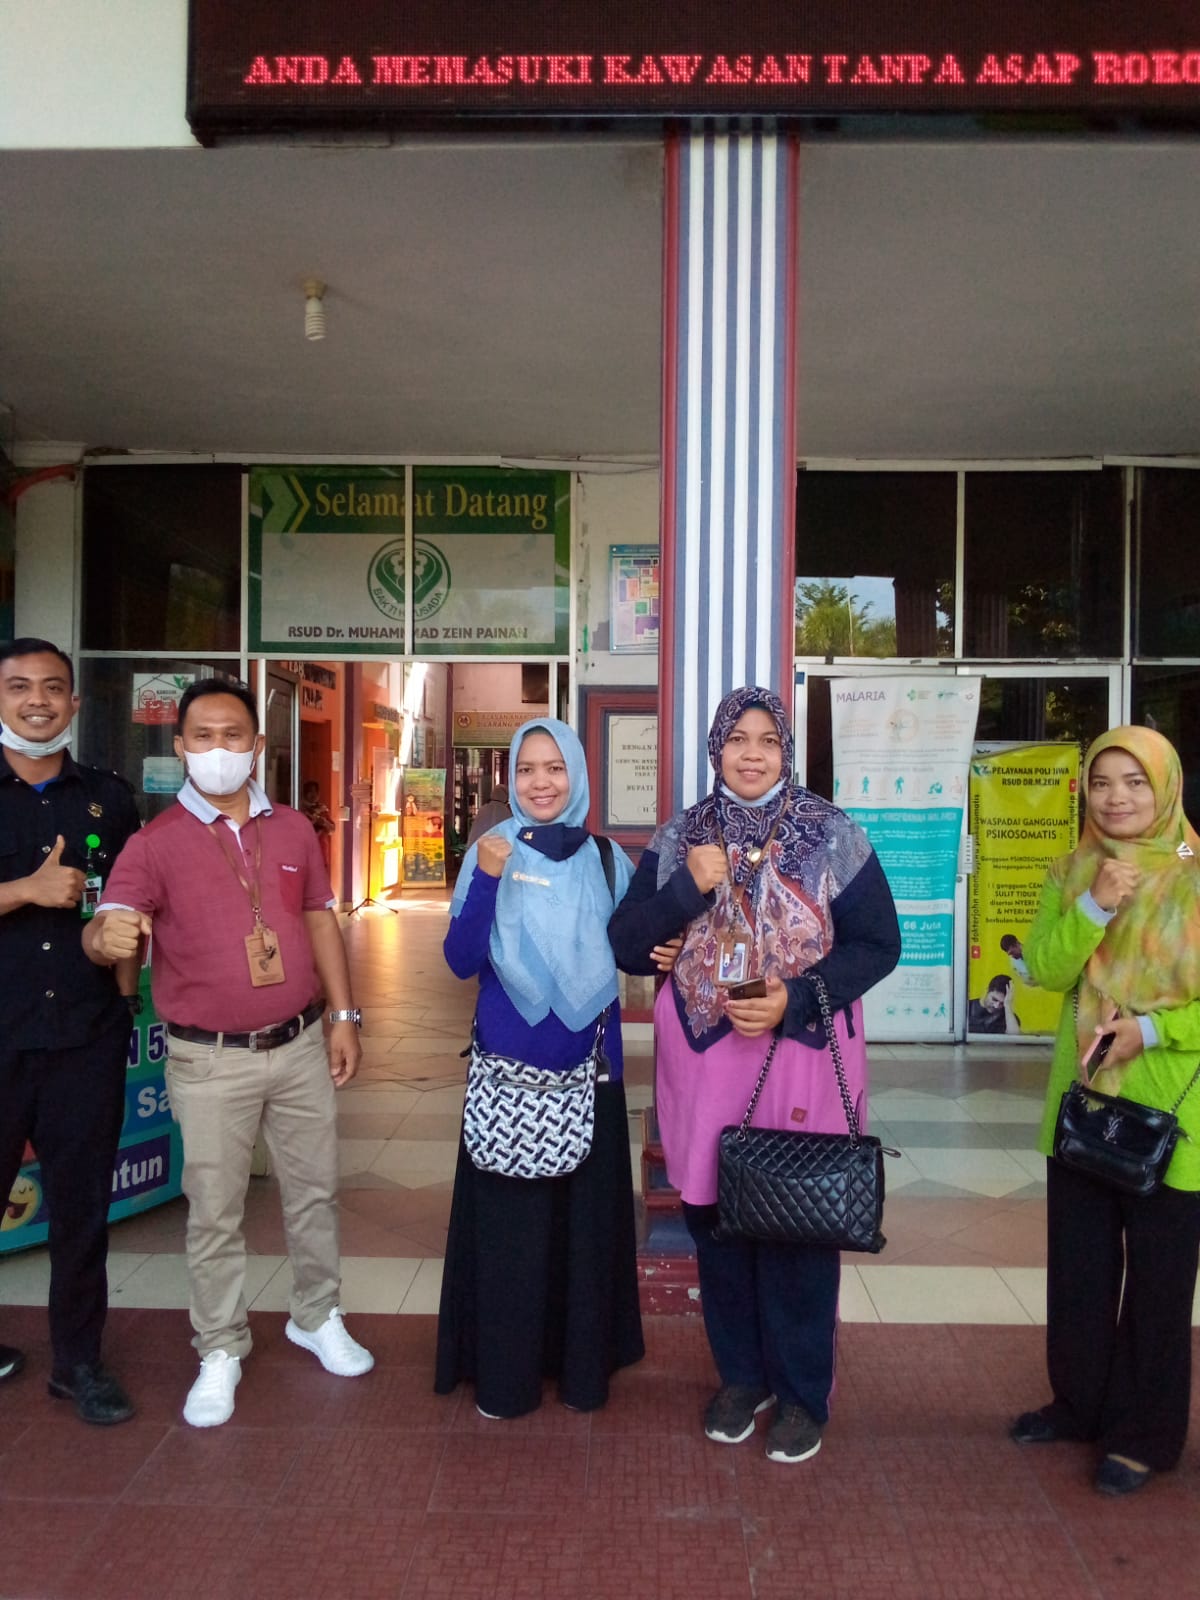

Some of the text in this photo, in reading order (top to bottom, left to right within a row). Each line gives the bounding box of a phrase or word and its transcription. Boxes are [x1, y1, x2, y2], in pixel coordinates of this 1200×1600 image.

[244, 55, 362, 85] ANDA
[372, 55, 592, 85] MEMASUKI
[603, 55, 812, 84] KAWASAN
[823, 55, 965, 84] TANPA
[976, 54, 1081, 84] ASAP
[444, 484, 548, 529] Datang
[288, 626, 323, 638] RSUD
[326, 626, 345, 638] Dr.
[443, 627, 473, 639] ZEIN
[476, 627, 528, 639] PAINAN
[836, 690, 886, 703] MALARIA
[992, 767, 1033, 775] PELAYANAN
[1035, 767, 1051, 775] POLI
[1002, 778, 1021, 786] RSUD
[980, 818, 1068, 826] WASPADAI GANGGUAN
[986, 829, 1056, 839] PSIKOSOMATIS
